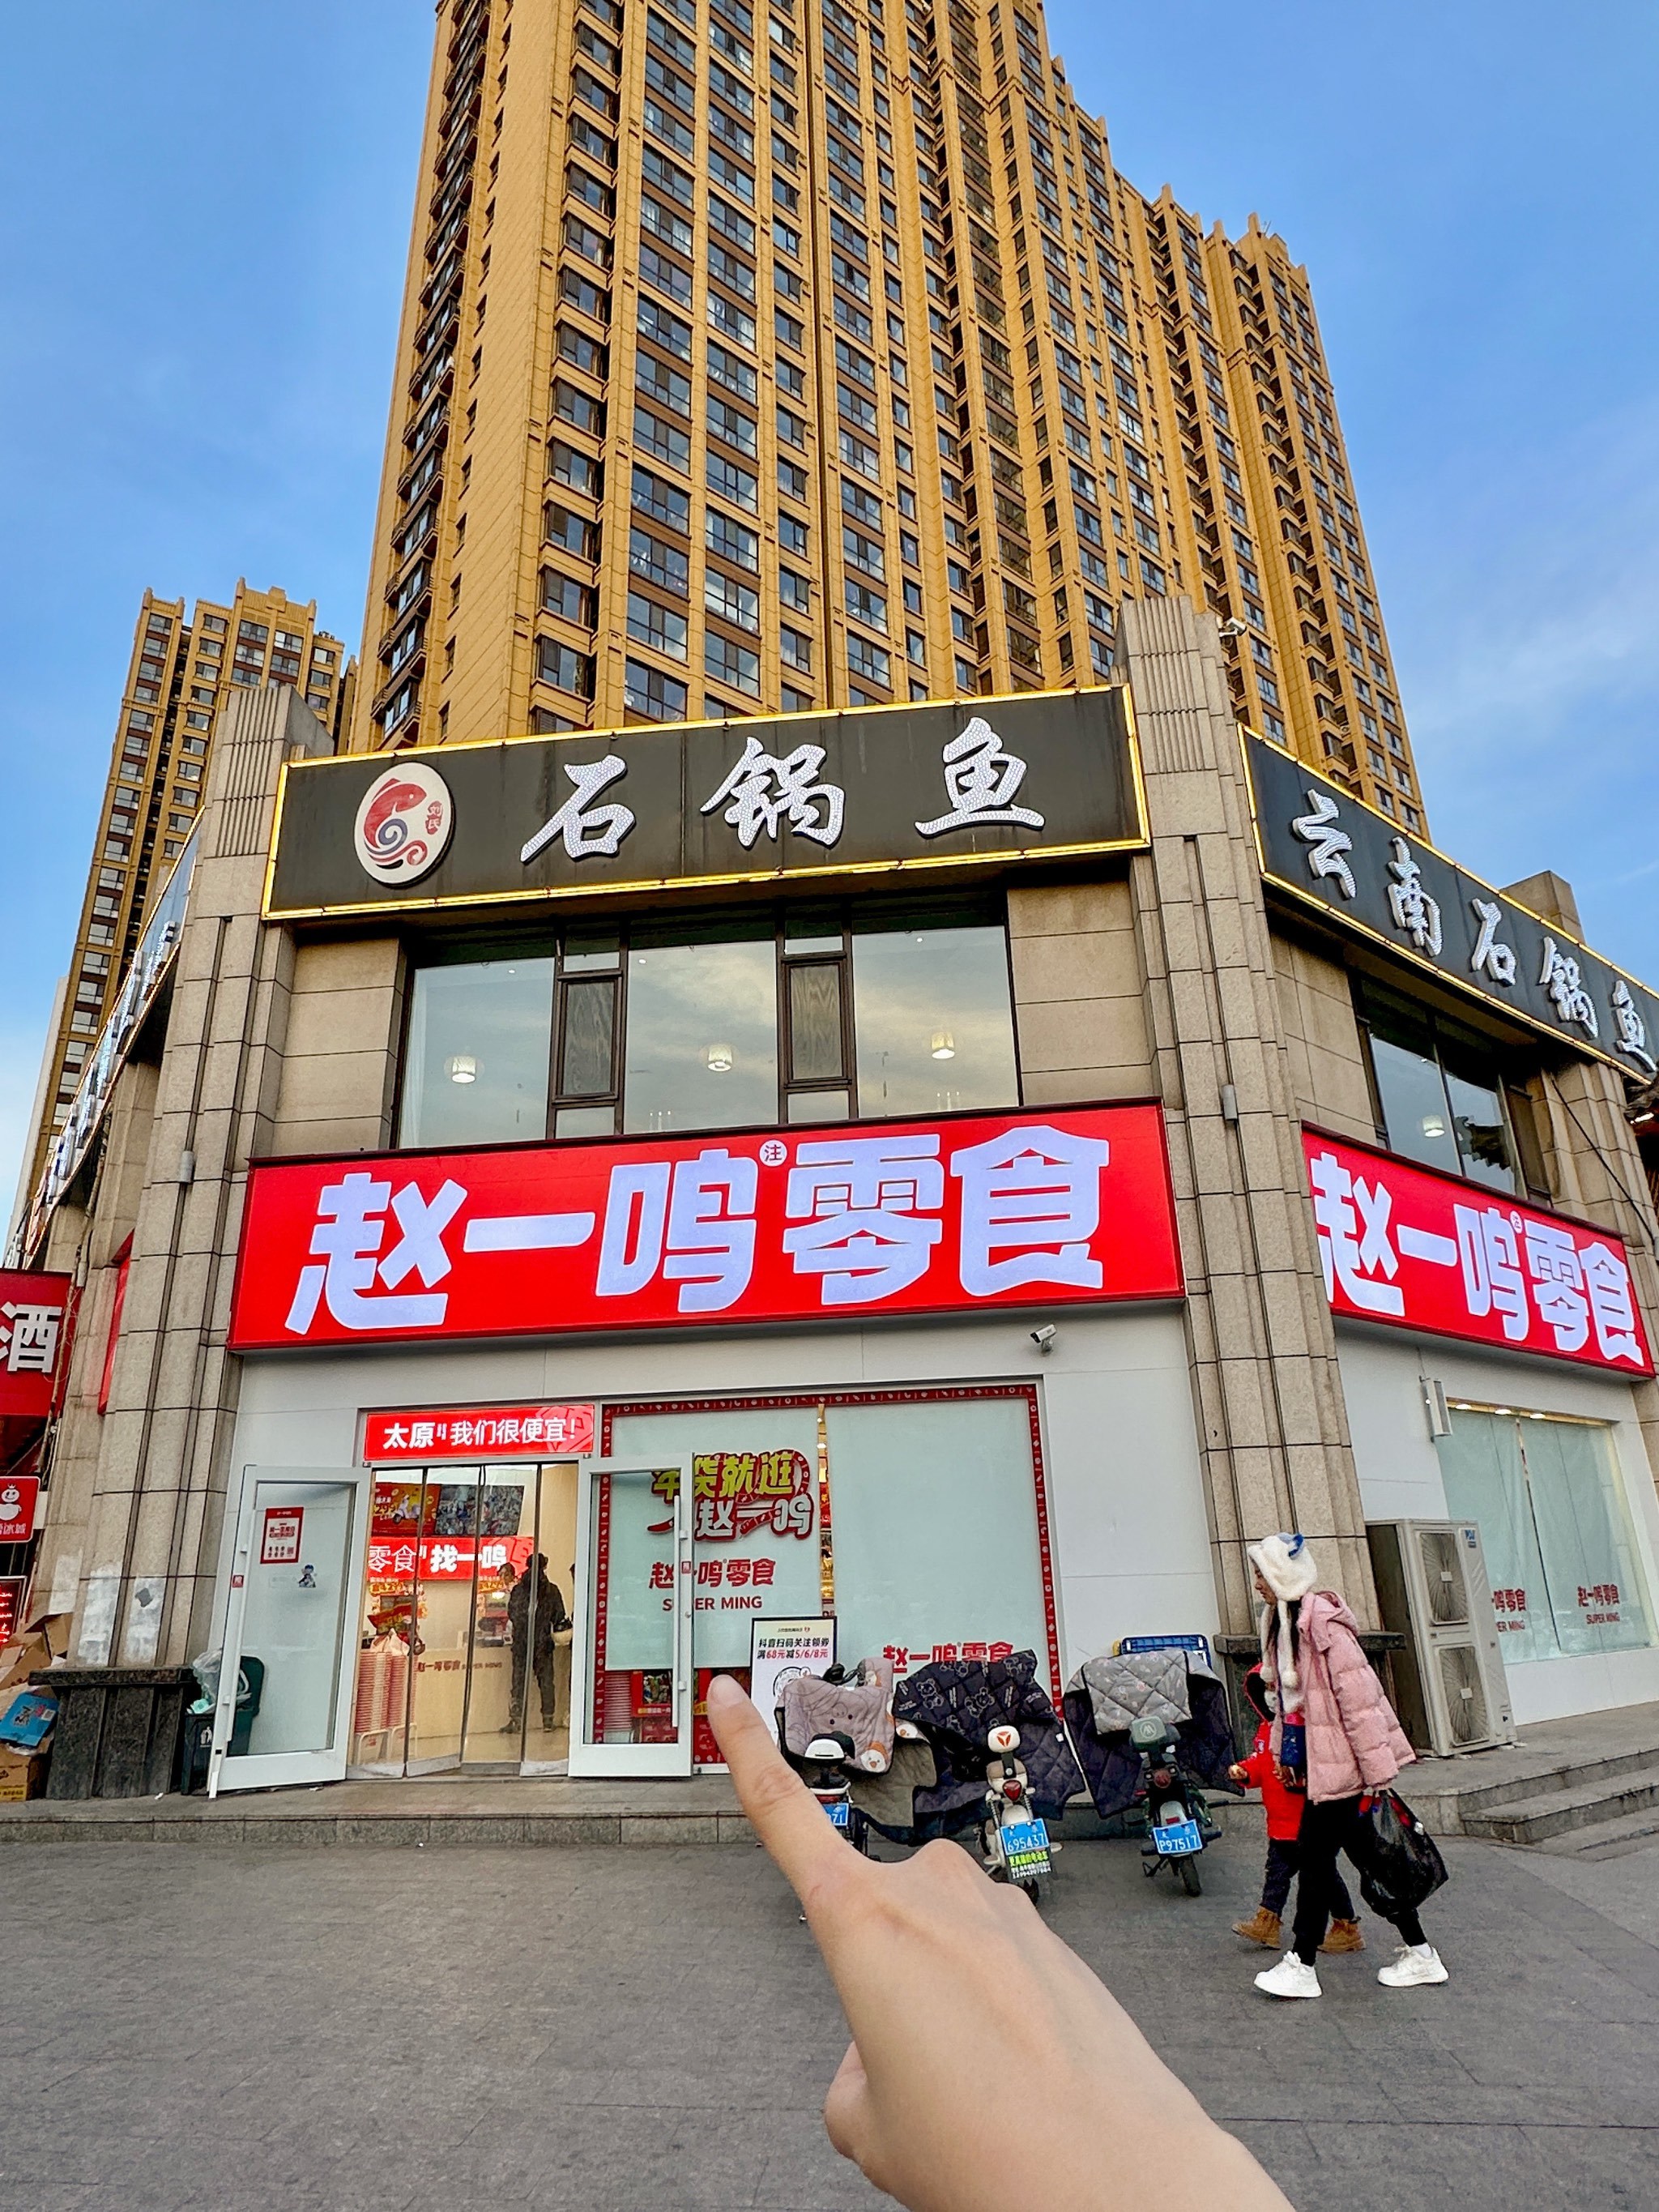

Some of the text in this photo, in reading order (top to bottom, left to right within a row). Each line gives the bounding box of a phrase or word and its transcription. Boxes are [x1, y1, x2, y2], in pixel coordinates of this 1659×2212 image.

[520, 717, 1045, 864] 石锅鱼
[1292, 788, 1657, 1073] 云南石锅鱼
[284, 1125, 1109, 1335] 赵一鸣零食
[1310, 1151, 1644, 1367] 赵一鸣零食
[0, 1301, 62, 1373] 酒
[0, 1522, 26, 1535] 冰城
[649, 1558, 775, 1590] 赵鸣零食
[663, 1595, 762, 1611] SER MING
[1492, 1589, 1526, 1612] 鸣零食
[1158, 1834, 1197, 1851] P97517
